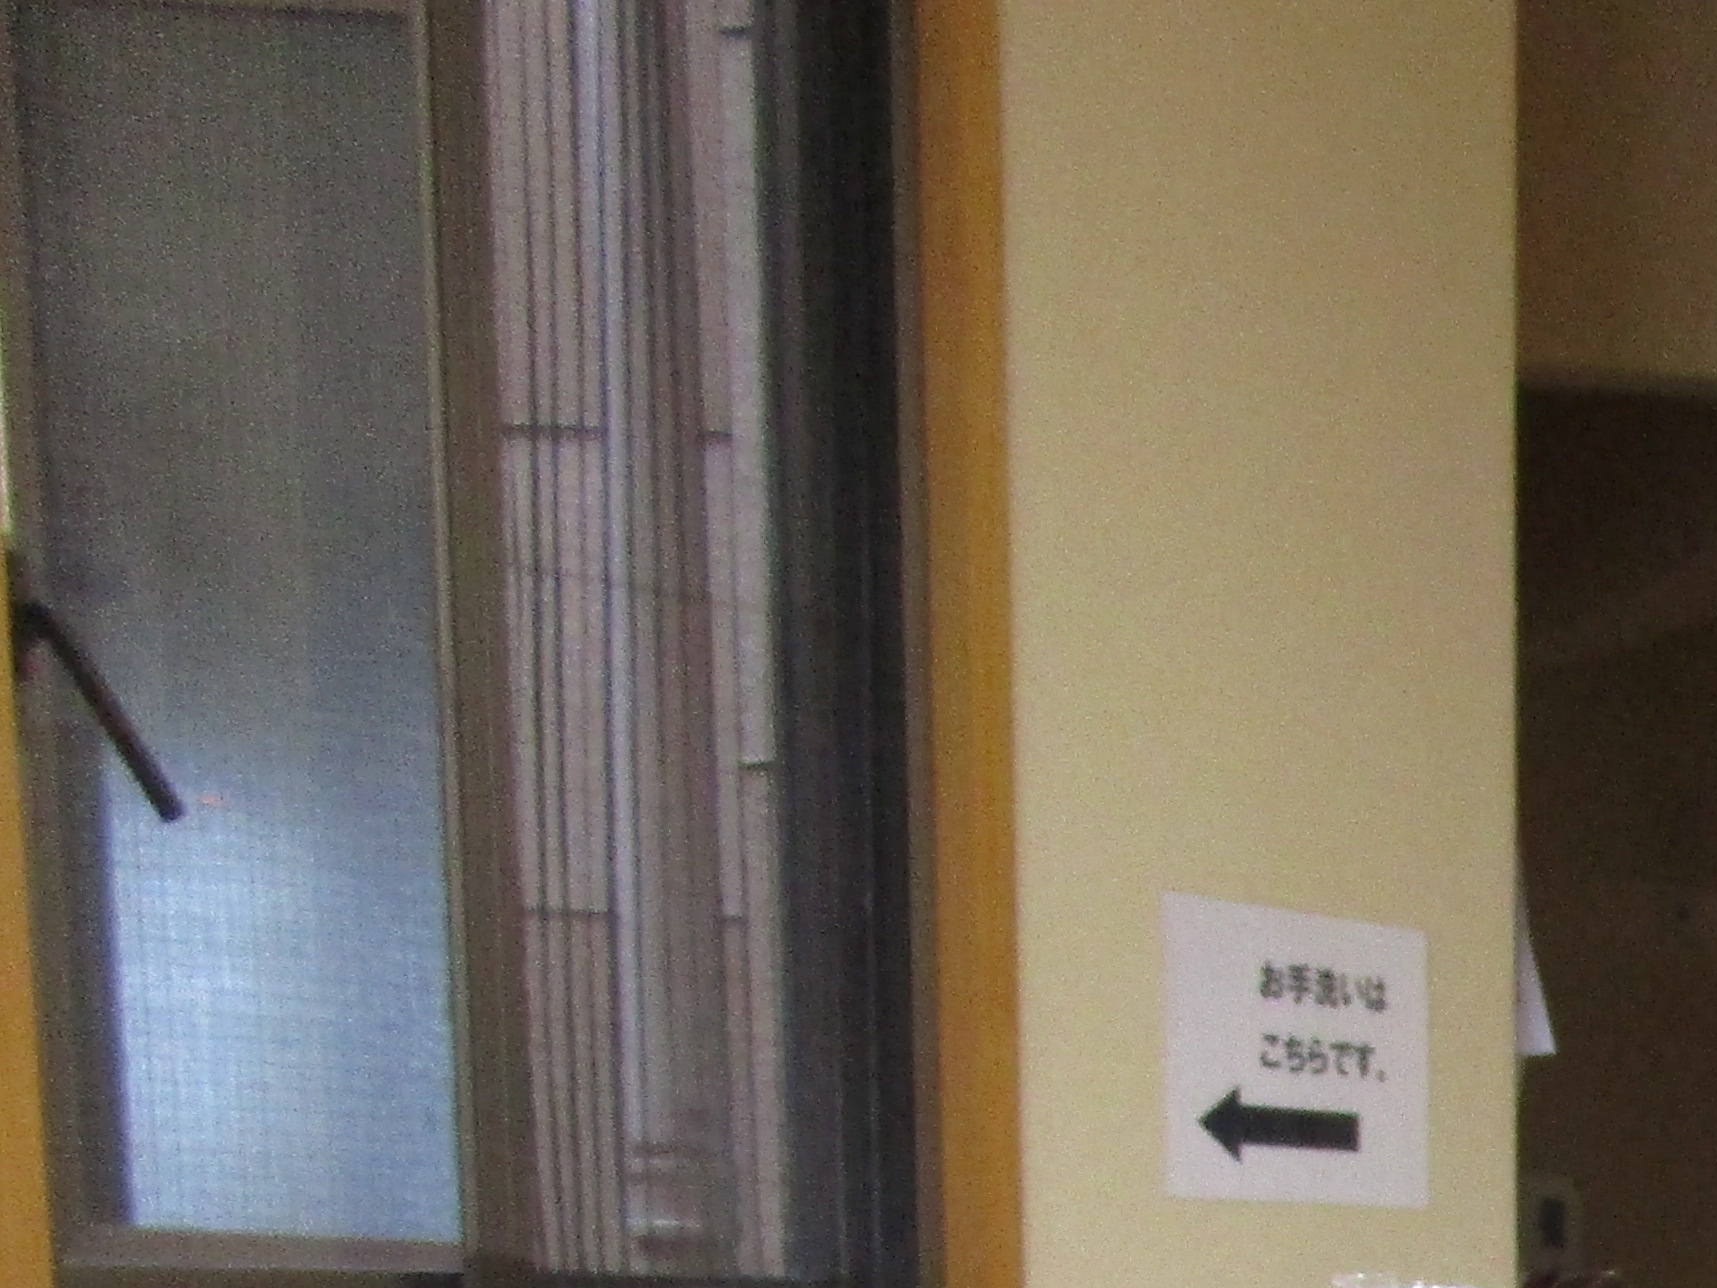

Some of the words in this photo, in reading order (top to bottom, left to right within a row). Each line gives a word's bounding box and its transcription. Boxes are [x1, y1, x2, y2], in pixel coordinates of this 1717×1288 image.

[1259, 961, 1387, 1013] お手洗いは
[1259, 1033, 1387, 1082] こちらです。
